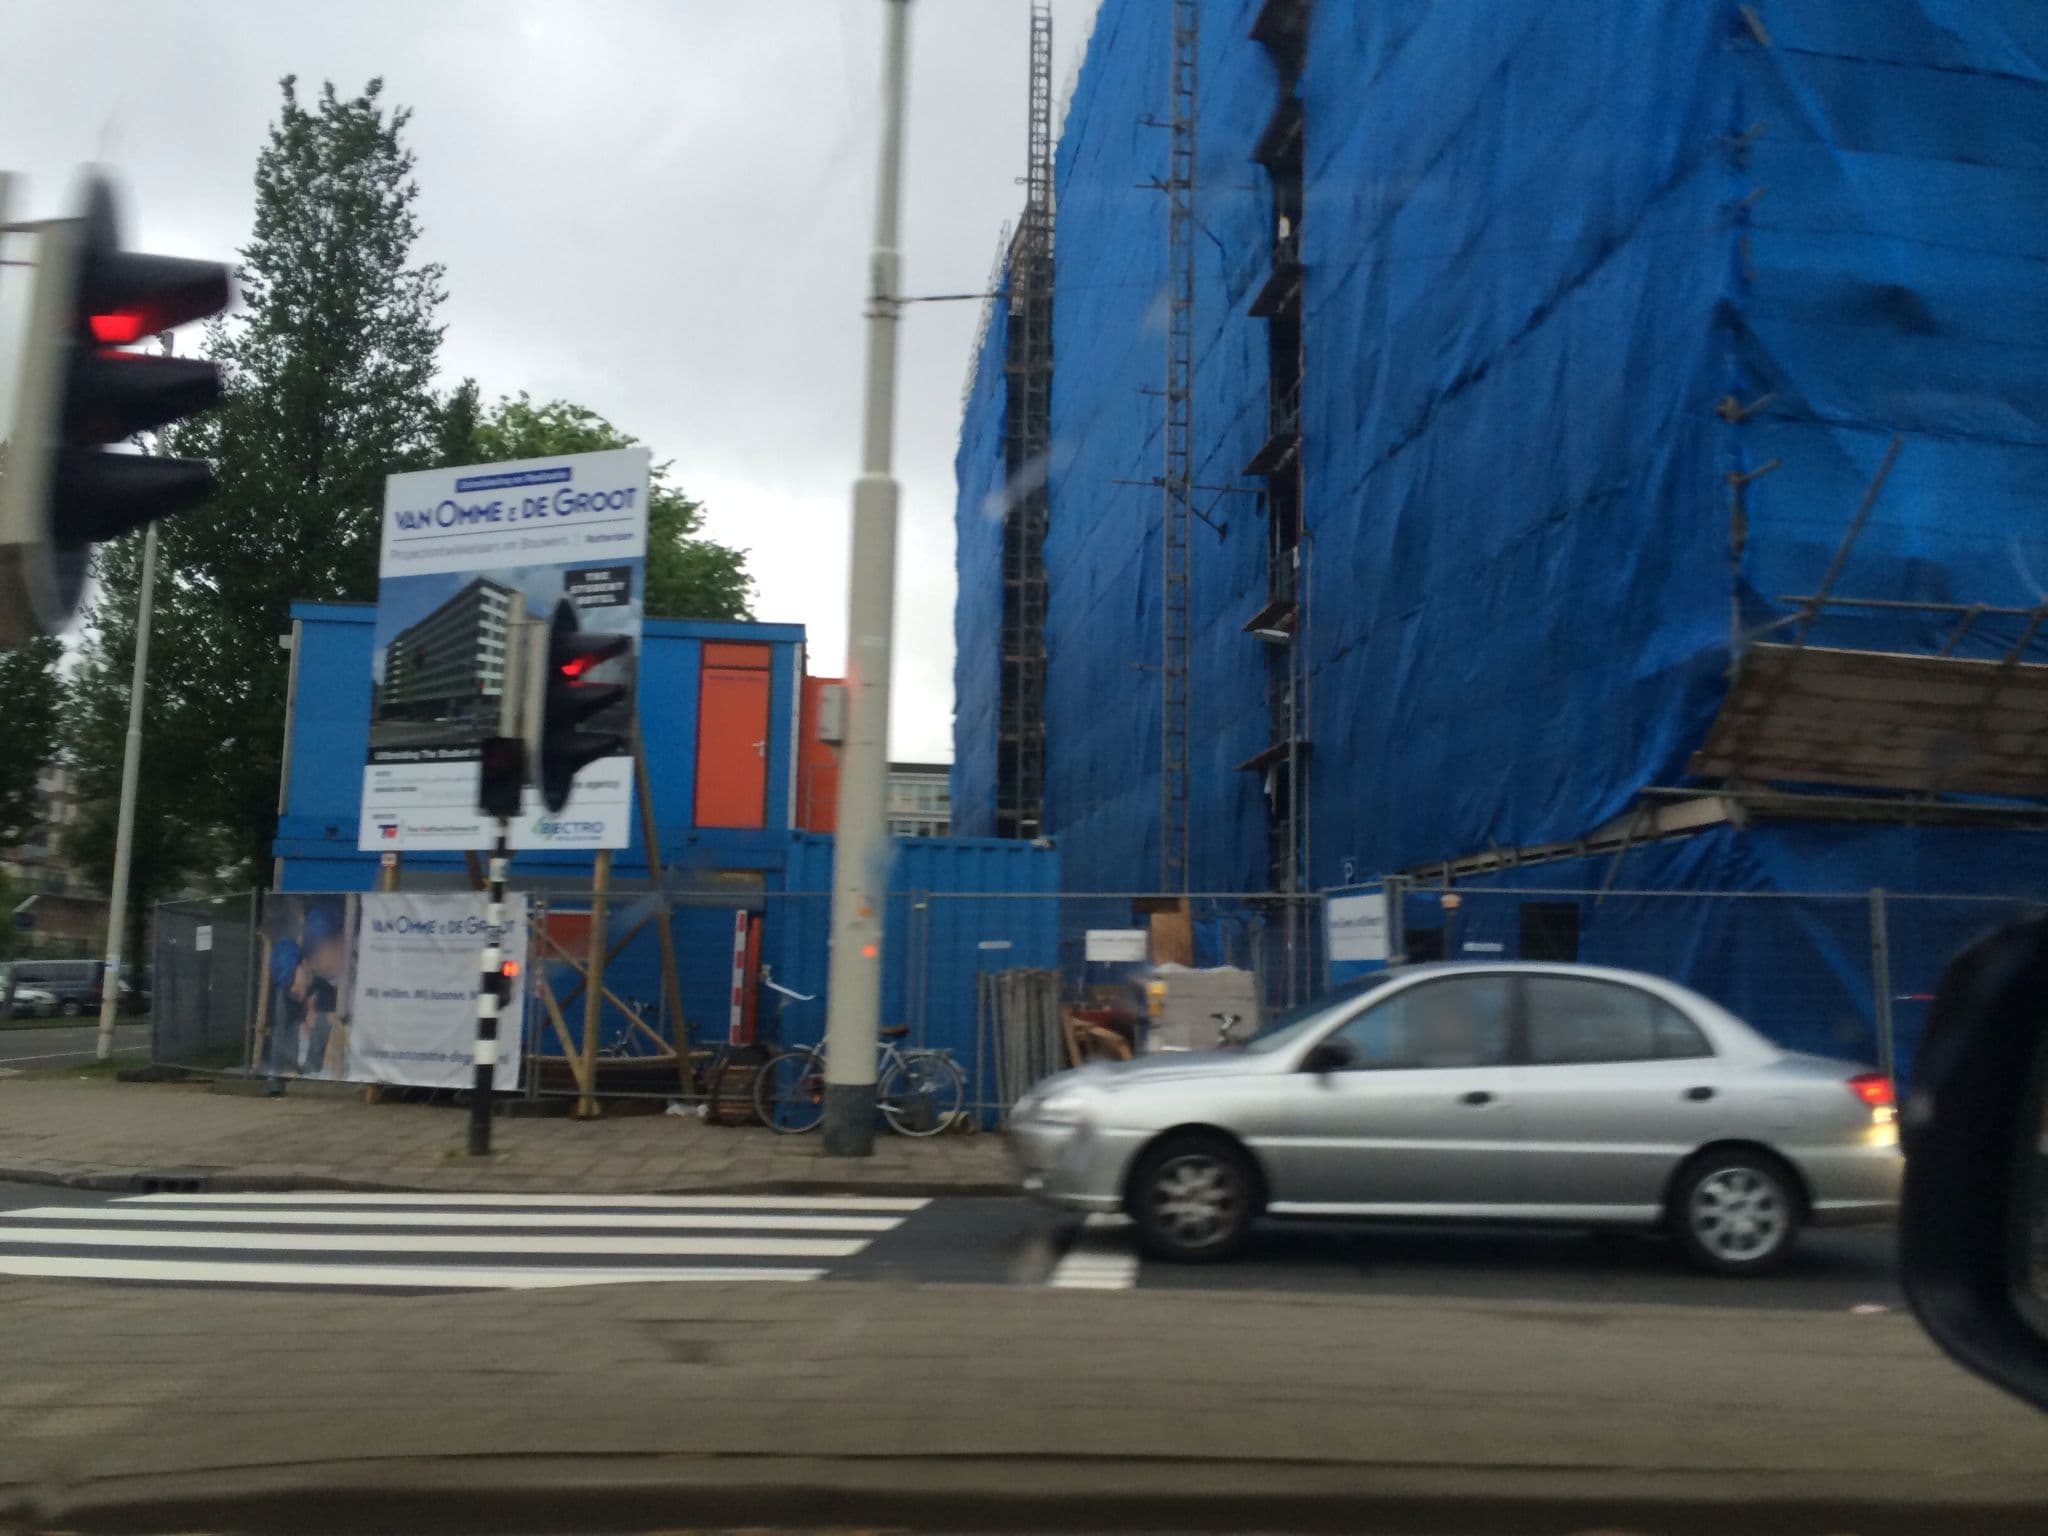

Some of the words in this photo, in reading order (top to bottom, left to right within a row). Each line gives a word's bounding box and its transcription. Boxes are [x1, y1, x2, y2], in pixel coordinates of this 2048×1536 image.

[395, 510, 433, 530] VAN
[435, 499, 504, 528] OMME
[521, 495, 549, 519] DE
[553, 487, 638, 517] GROOT
